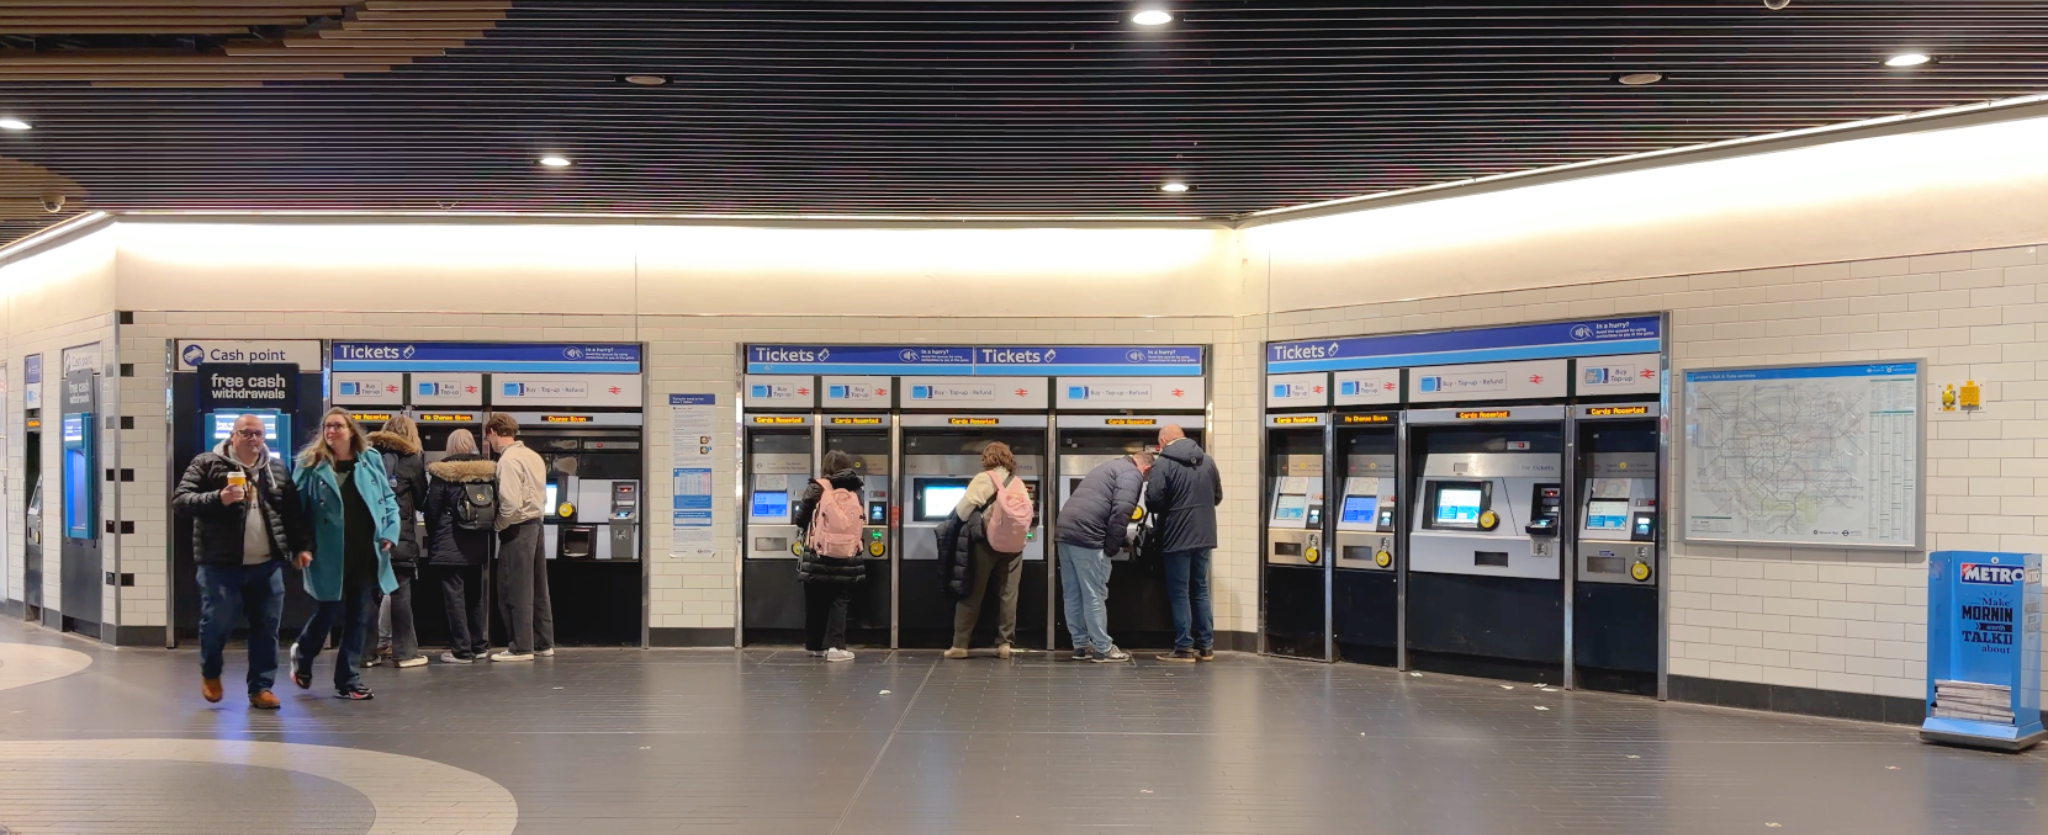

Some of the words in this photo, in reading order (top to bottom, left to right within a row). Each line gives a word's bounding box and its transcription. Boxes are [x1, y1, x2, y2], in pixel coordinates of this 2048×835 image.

[210, 349, 244, 360] Cash
[250, 349, 286, 363] point
[340, 345, 399, 359] Tickets
[756, 348, 814, 361] Tickets
[982, 349, 1040, 363] Tickets
[1274, 345, 1325, 360] Tickets
[211, 373, 244, 388] free
[248, 373, 285, 388] cash
[212, 387, 285, 399] withdrawals
[1964, 567, 2024, 582] METRO
[1982, 598, 2010, 606] Make
[1962, 605, 2013, 622] MORNIN
[1982, 644, 2010, 654] about
